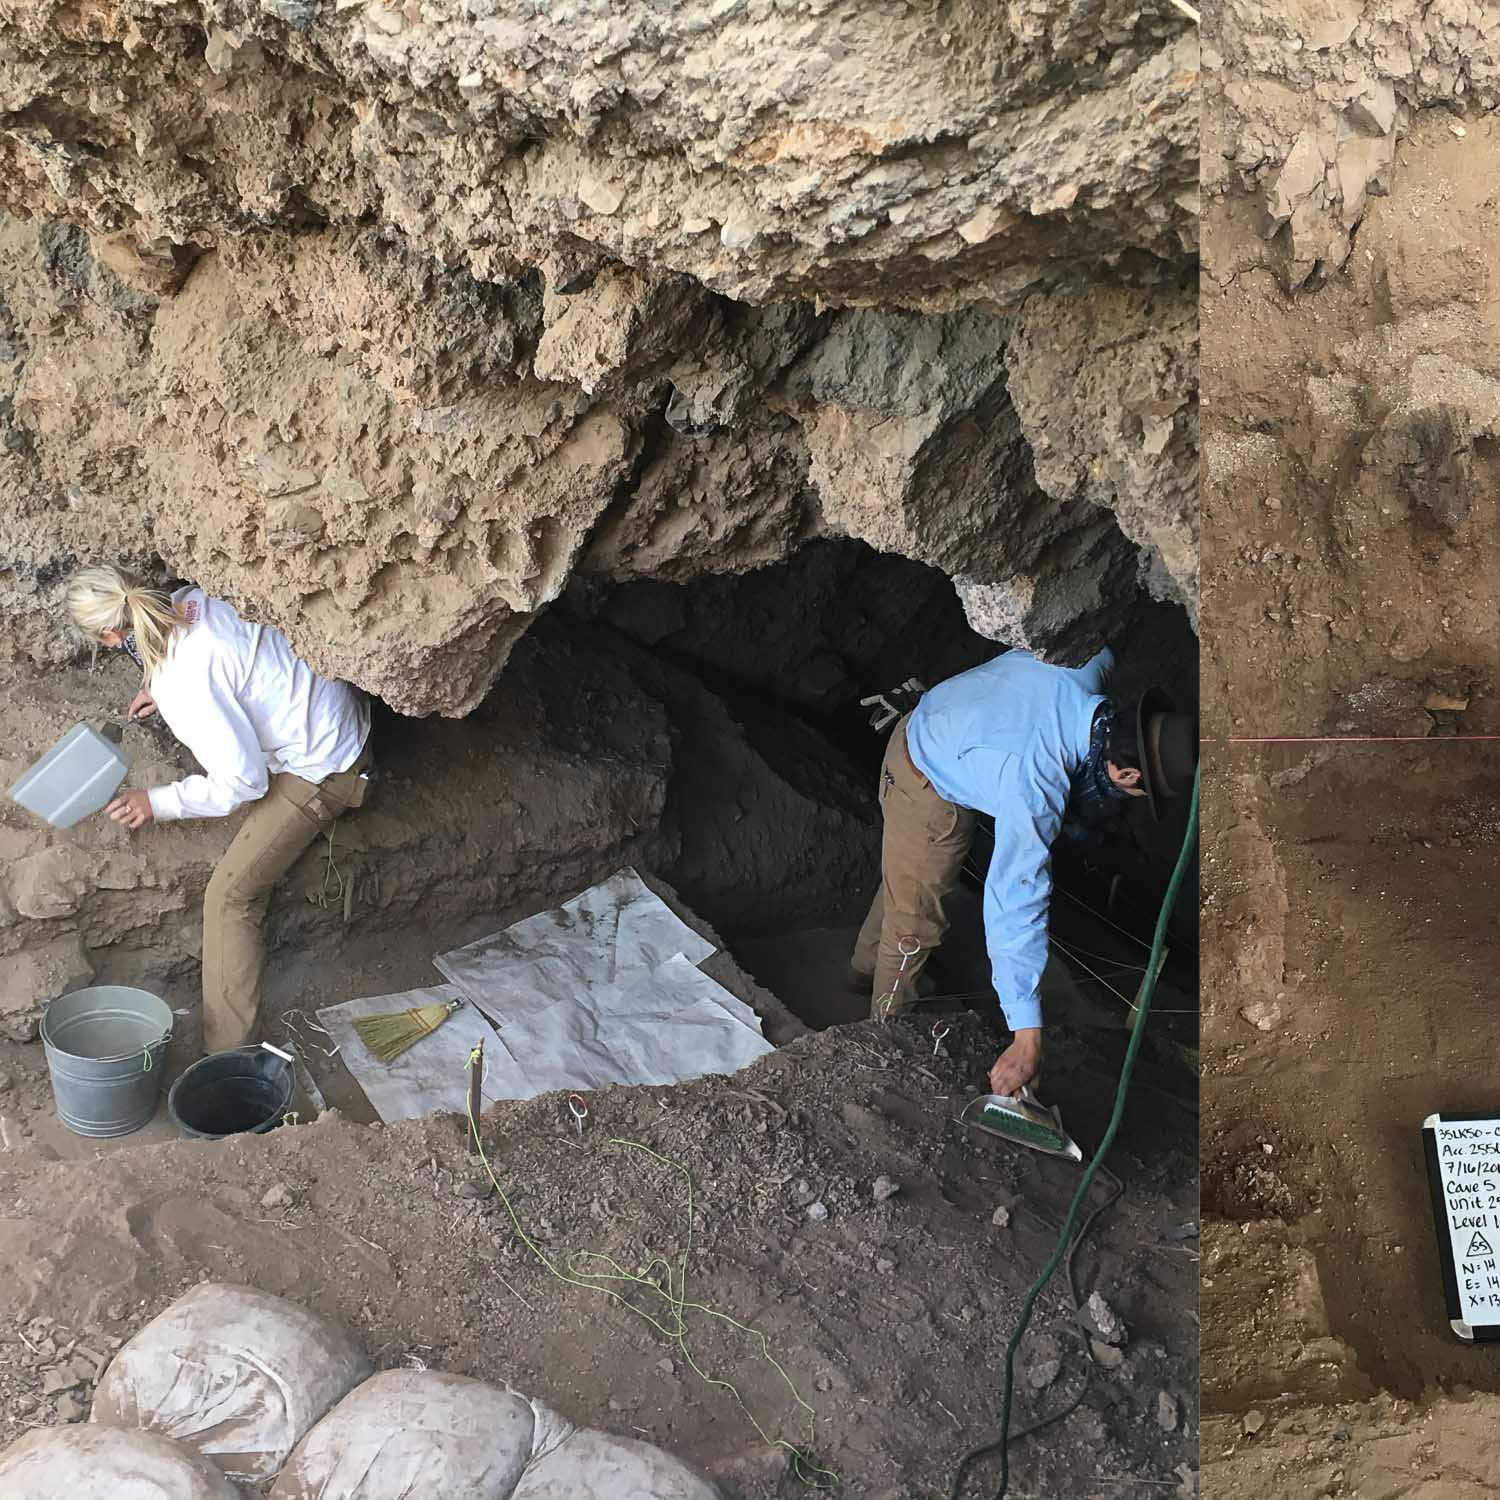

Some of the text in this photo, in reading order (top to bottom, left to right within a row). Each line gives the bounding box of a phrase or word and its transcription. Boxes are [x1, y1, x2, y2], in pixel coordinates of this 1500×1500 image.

[1438, 1128, 1482, 1140] 35LK50
[1446, 1179, 1496, 1194] Cave 5
[1452, 1214, 1487, 1230] Level
[1486, 1276, 1500, 1288] 14
